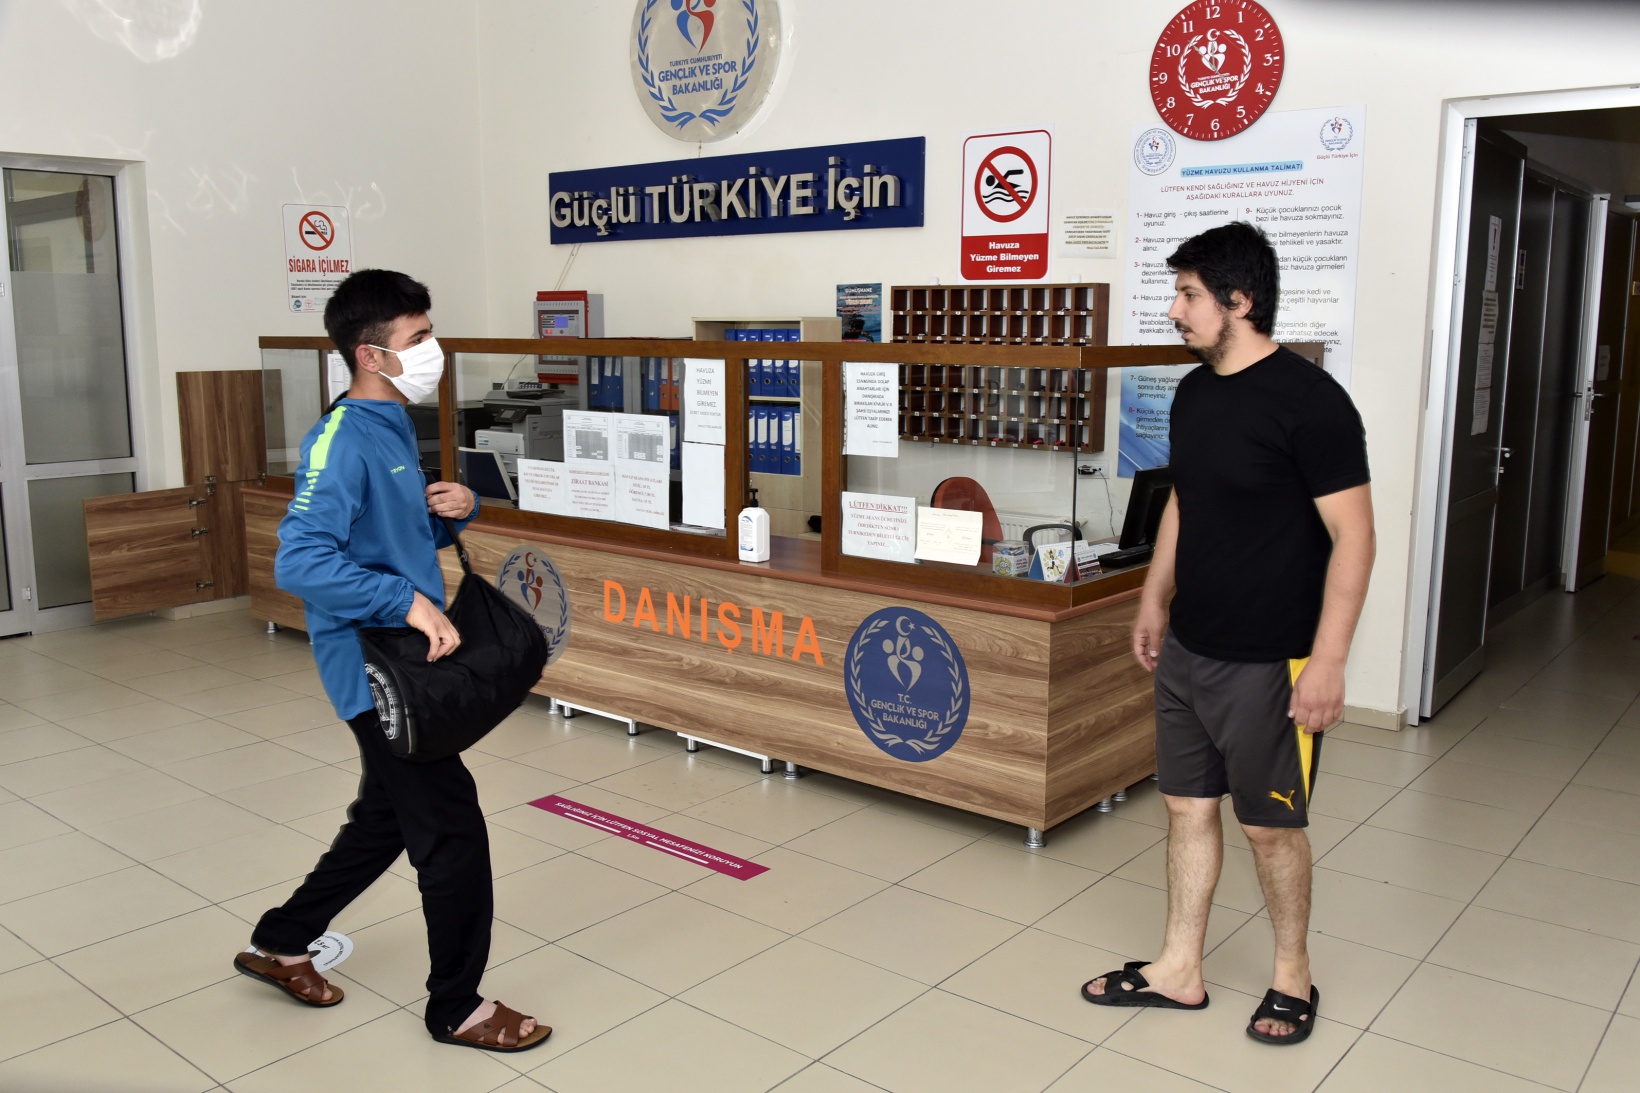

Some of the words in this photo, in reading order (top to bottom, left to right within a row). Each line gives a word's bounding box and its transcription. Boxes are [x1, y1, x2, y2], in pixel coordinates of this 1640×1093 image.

[1206, 6, 1220, 19] 12
[1238, 11, 1243, 23] 1
[1182, 21, 1194, 34] 11
[1255, 29, 1265, 41] 2
[1166, 44, 1181, 58] 10
[1264, 54, 1273, 66] 3
[658, 67, 698, 82] GENÇLİK
[699, 64, 711, 76] VE
[712, 60, 738, 75] SPOR
[1158, 72, 1168, 84] 9
[1223, 75, 1238, 83] SPOR
[672, 77, 723, 96] BAKANLIĞI
[1255, 83, 1265, 94] 4
[1166, 97, 1176, 108] 8
[1236, 106, 1246, 118] 5
[1186, 114, 1195, 125] 7
[1211, 119, 1220, 130] 6
[1233, 165, 1269, 173] KULLANMA
[1271, 163, 1303, 171] TALİMATI
[1161, 185, 1184, 193] LÜTFEN
[1187, 184, 1206, 192] KENDİ
[1208, 181, 1244, 190] SAĞLIĞINIZ
[1309, 177, 1324, 186] İÇİN
[550, 186, 640, 236] Güçlü
[645, 167, 820, 224] TÜRKİYE
[827, 156, 901, 221] İçin
[1222, 191, 1262, 199] KURALLARA
[1256, 206, 1276, 214] Küçük
[1321, 204, 1341, 212] çocuk
[989, 242, 1021, 250] Havuza
[970, 253, 998, 262] Yüzme
[1000, 252, 1040, 263] Bilmeyen
[289, 255, 317, 273] SİGARA
[318, 255, 350, 277] İÇİLMEZ
[986, 264, 1022, 273] Giremez
[849, 500, 875, 509] LÜTFEN
[604, 579, 824, 666] DANIŞMA
[871, 699, 905, 715] GENÇLİK
[907, 706, 917, 717] VE
[917, 710, 939, 725] SPOR
[882, 712, 928, 730] BAKANLIĞI
[606, 819, 633, 831] LÜTFEN
[703, 852, 743, 869] KORUYUN
